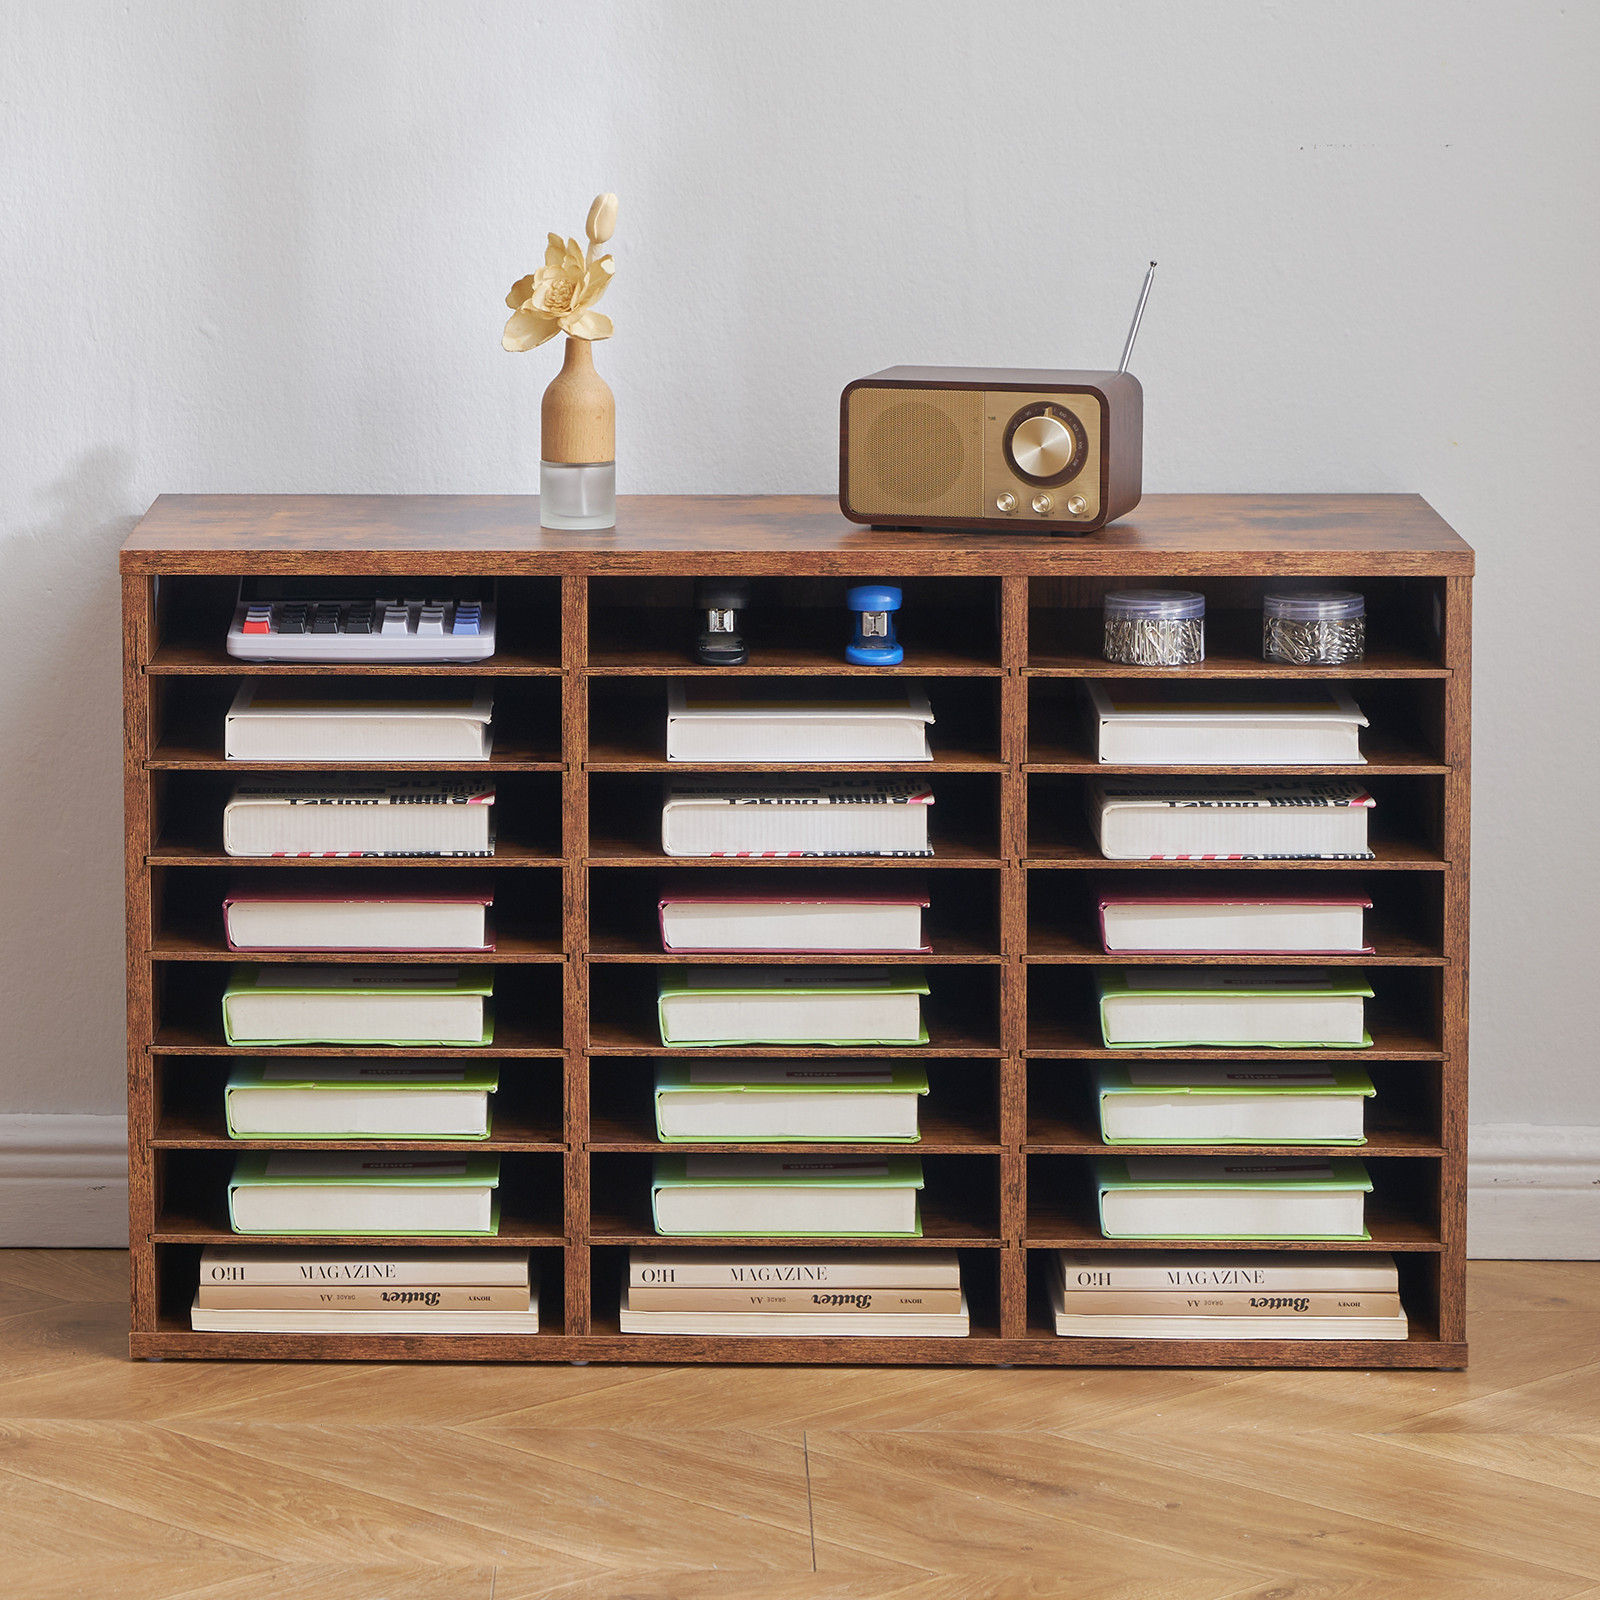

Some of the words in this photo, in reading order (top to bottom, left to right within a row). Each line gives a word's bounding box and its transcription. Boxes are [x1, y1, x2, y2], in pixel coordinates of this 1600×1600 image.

[300, 1264, 396, 1280] MAGAZINE
[729, 1266, 828, 1282] MAGAZINE
[1166, 1269, 1265, 1286] MAGAZINE
[380, 1292, 441, 1306] Butter
[811, 1295, 872, 1309] Butter
[1249, 1298, 1310, 1312] Butter
